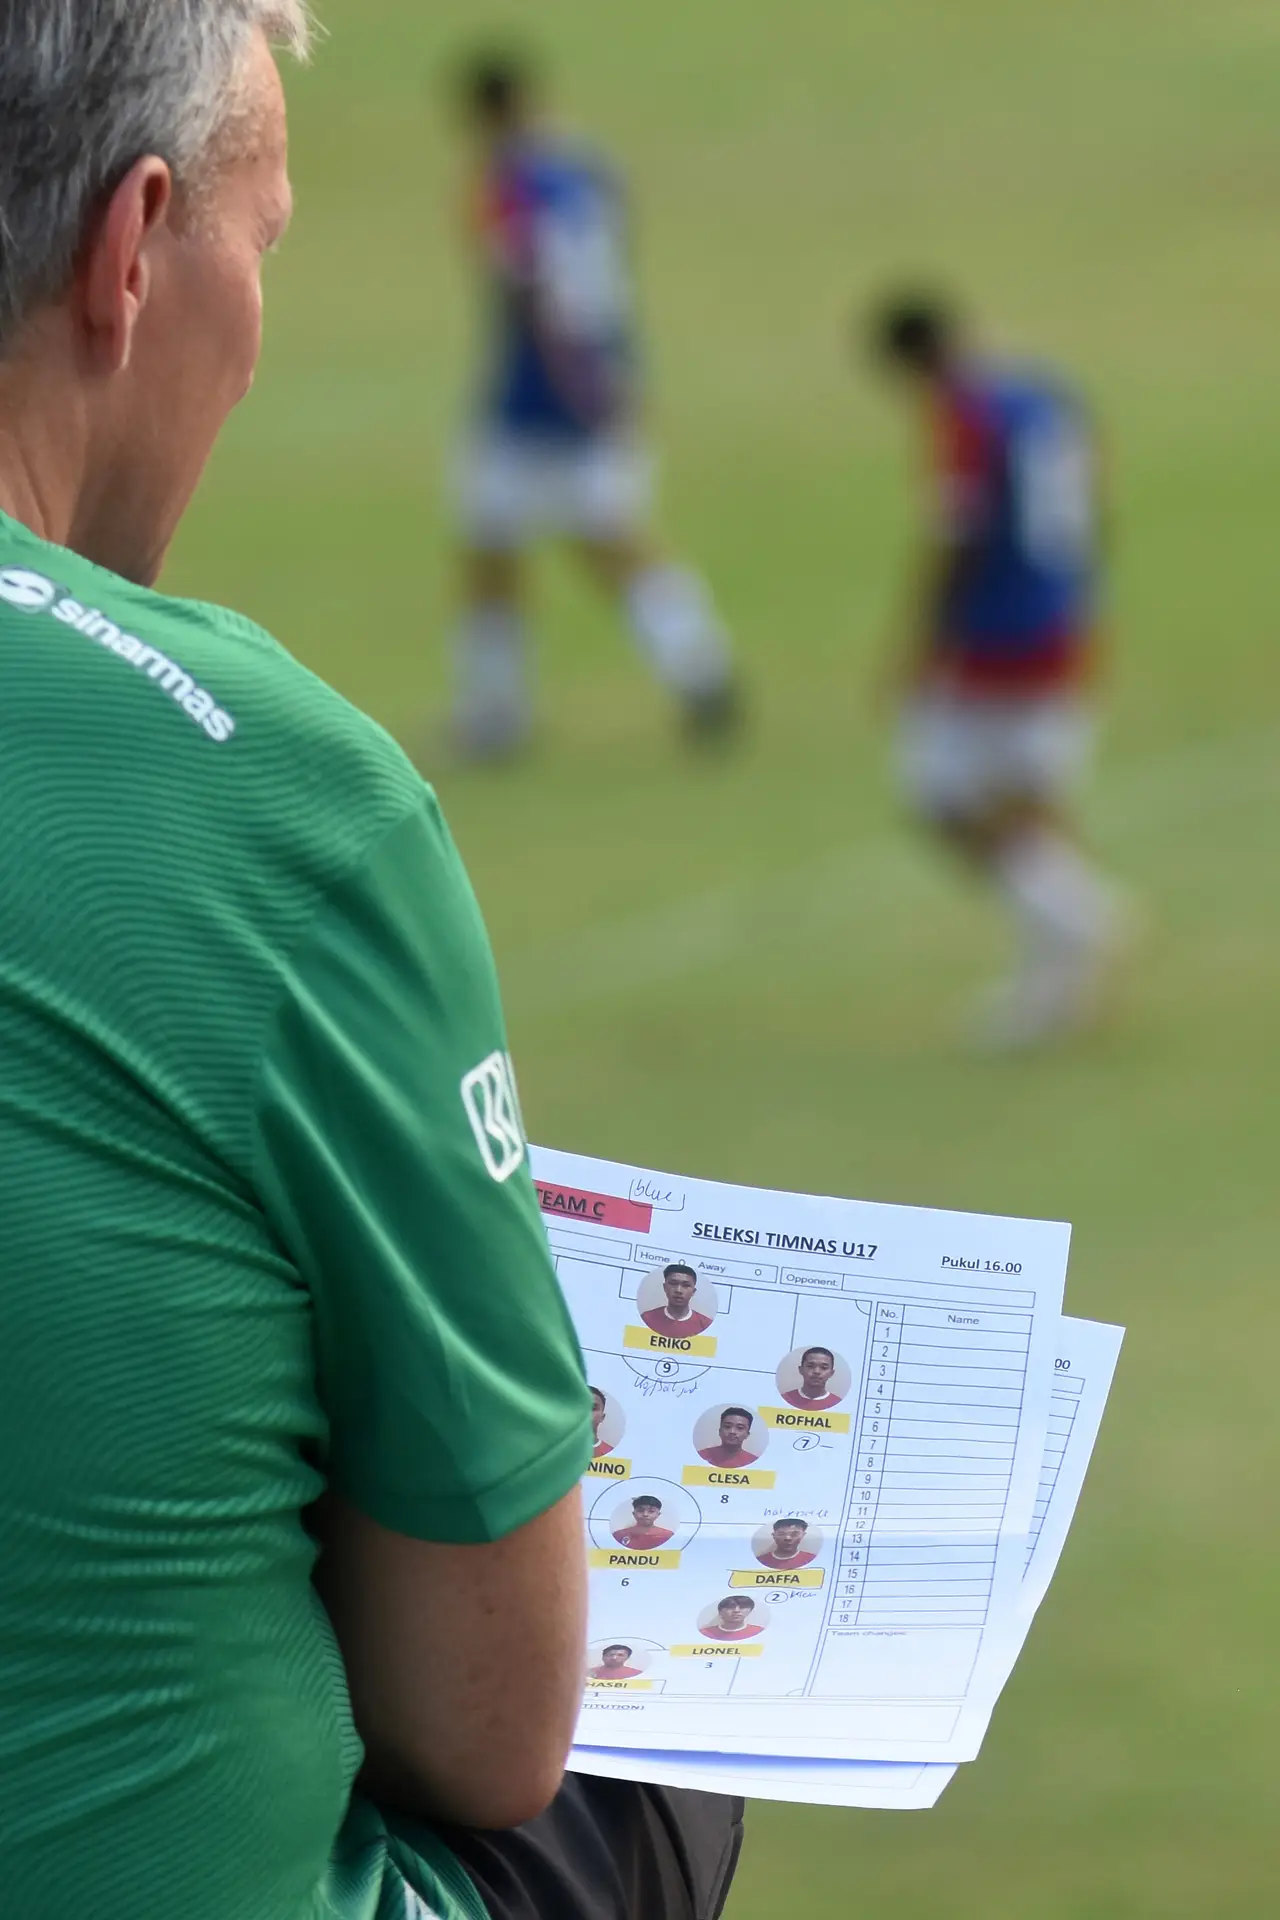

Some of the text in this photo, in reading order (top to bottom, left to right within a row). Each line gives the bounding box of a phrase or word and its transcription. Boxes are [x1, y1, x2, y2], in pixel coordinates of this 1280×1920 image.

[51, 597, 235, 742] sinarmas
[536, 1187, 606, 1217] TEAM C
[693, 1221, 878, 1258] SELEKSI TIMNAS U17
[640, 1251, 671, 1264] Home
[697, 1261, 727, 1274] Away
[941, 1256, 1023, 1275] Pukul 16.00
[880, 1308, 981, 1325] No. Name
[885, 1326, 891, 1339] 1
[649, 1335, 692, 1351] ERIKO
[882, 1345, 890, 1358] 2
[662, 1360, 672, 1374] 9
[879, 1365, 887, 1377] 3
[877, 1384, 885, 1396] 4
[874, 1402, 882, 1415] 5
[775, 1413, 832, 1429] ROFHAL
[872, 1421, 880, 1433] 6
[801, 1438, 810, 1449] 7
[870, 1439, 878, 1450] 7
[867, 1457, 875, 1468] 8
[708, 1472, 750, 1485] CLESA
[864, 1474, 872, 1485] 9
[720, 1494, 729, 1505] 8
[860, 1491, 872, 1501] 10
[857, 1506, 869, 1517] 11
[854, 1520, 866, 1530] 12
[851, 1533, 863, 1545] 13
[609, 1555, 660, 1567] PANDU
[849, 1552, 861, 1562] 14
[755, 1574, 801, 1585] DAFFA
[847, 1568, 859, 1579] 15
[621, 1577, 630, 1587] 6
[844, 1585, 856, 1595] 16
[771, 1593, 780, 1602] 2
[841, 1600, 853, 1609] 17
[838, 1614, 849, 1623] 18
[692, 1647, 741, 1656] LIONEL
